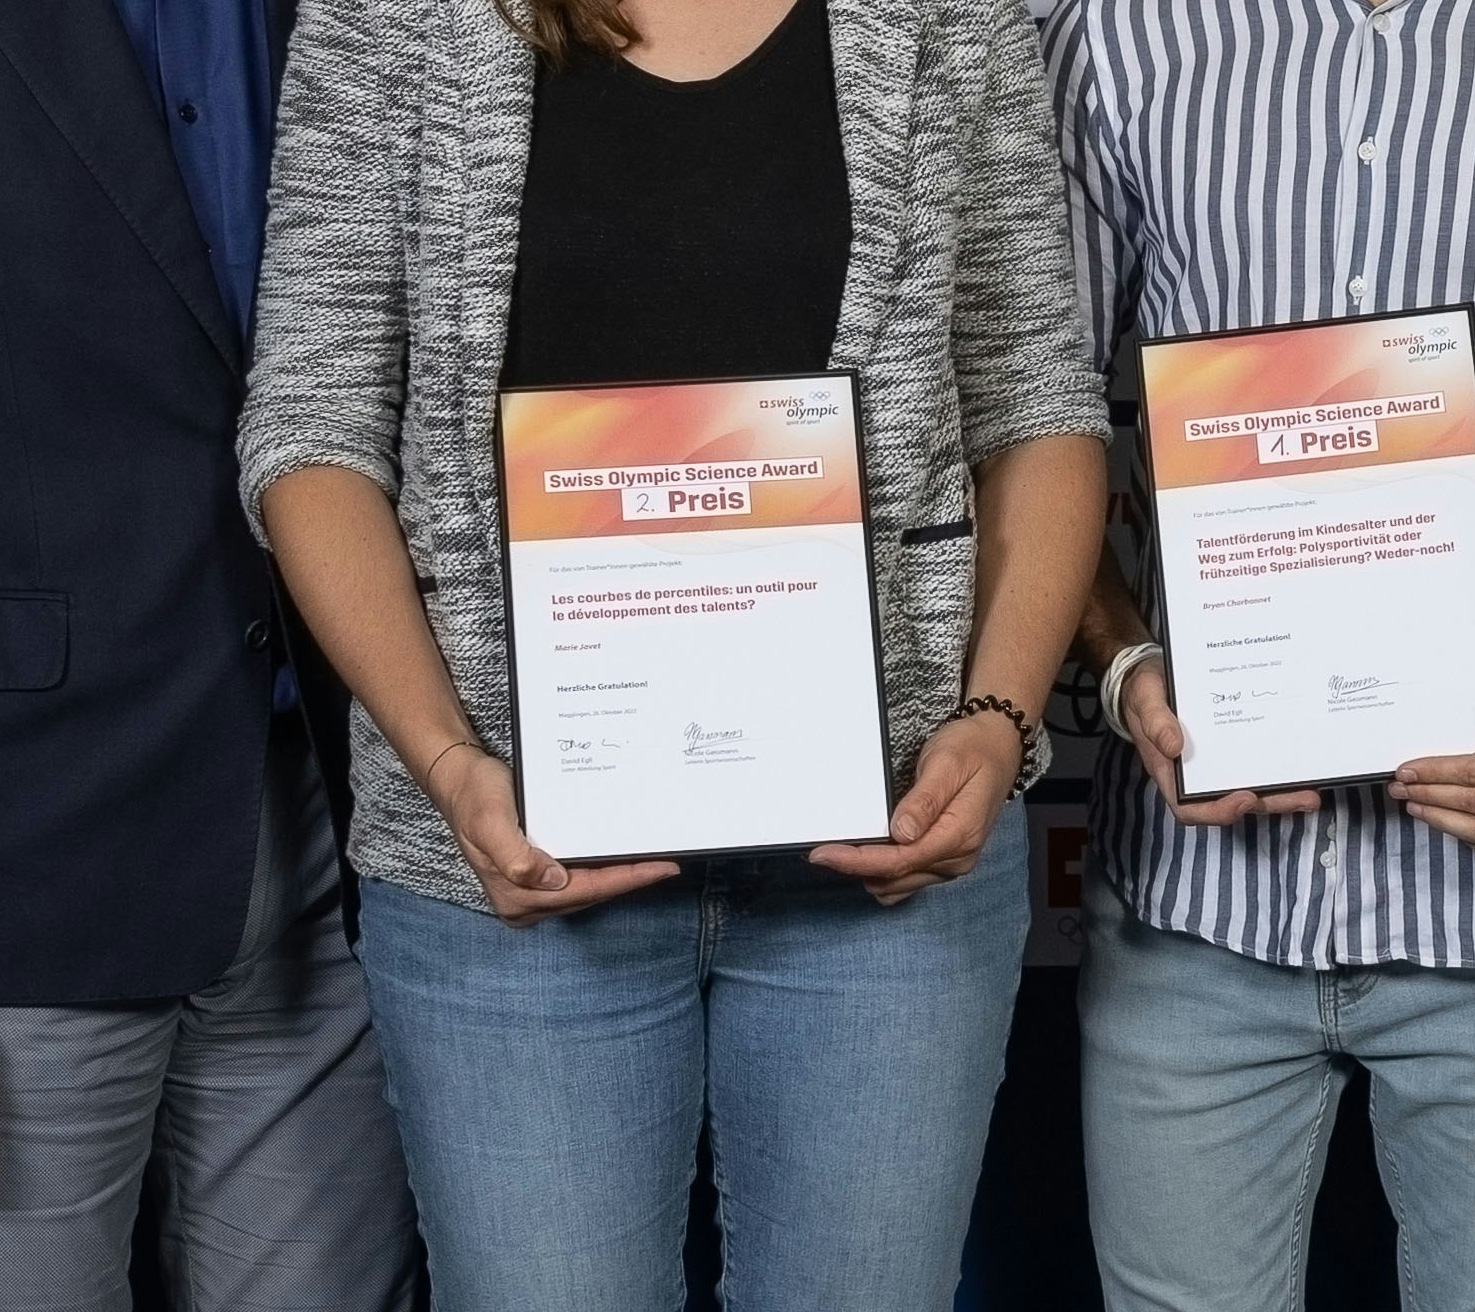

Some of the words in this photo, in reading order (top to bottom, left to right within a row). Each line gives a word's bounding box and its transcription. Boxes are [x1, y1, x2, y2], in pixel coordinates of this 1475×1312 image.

[1392, 334, 1424, 347] swiss
[1408, 339, 1456, 355] olympic
[770, 396, 804, 408] swiss
[787, 404, 839, 419] olympic
[1190, 420, 1240, 436] Swiss
[1244, 411, 1312, 431] Olympic
[1315, 405, 1383, 422] Science
[1387, 396, 1439, 415] Award
[1300, 426, 1371, 454] Preis
[550, 472, 604, 488] Swiss
[608, 468, 681, 487] Olympic
[685, 465, 757, 481] Science
[761, 461, 817, 477] Award
[668, 487, 745, 513] Preis
[1196, 530, 1296, 549] Talentförderung
[1298, 527, 1313, 538] im
[1316, 520, 1387, 536] Kindesalter
[1389, 515, 1413, 527] und
[1415, 514, 1436, 524] der
[1198, 554, 1226, 565] Weg
[1228, 551, 1254, 561] zum
[1257, 545, 1297, 558] Erfolg:
[1299, 533, 1391, 553] Polysportivität
[1394, 531, 1422, 543] oder
[1200, 564, 1267, 580] frühzeitige
[1269, 551, 1372, 574] Spezialisierung?
[1374, 541, 1455, 560] Weder-noch!
[552, 595, 574, 605] Les
[577, 591, 632, 603] courbes
[635, 589, 651, 600] de
[654, 585, 733, 601] percentiles:
[736, 585, 752, 594] un
[755, 581, 785, 593] outil
[788, 582, 818, 593] pour
[552, 611, 564, 621] le
[568, 605, 671, 620] développement
[674, 603, 698, 614] des
[701, 599, 755, 613] talents?
[1207, 639, 1243, 649] Herzliche
[1244, 633, 1291, 645] Gratulation!
[557, 684, 596, 693] Herzliche
[597, 681, 648, 691] Gratulation!
